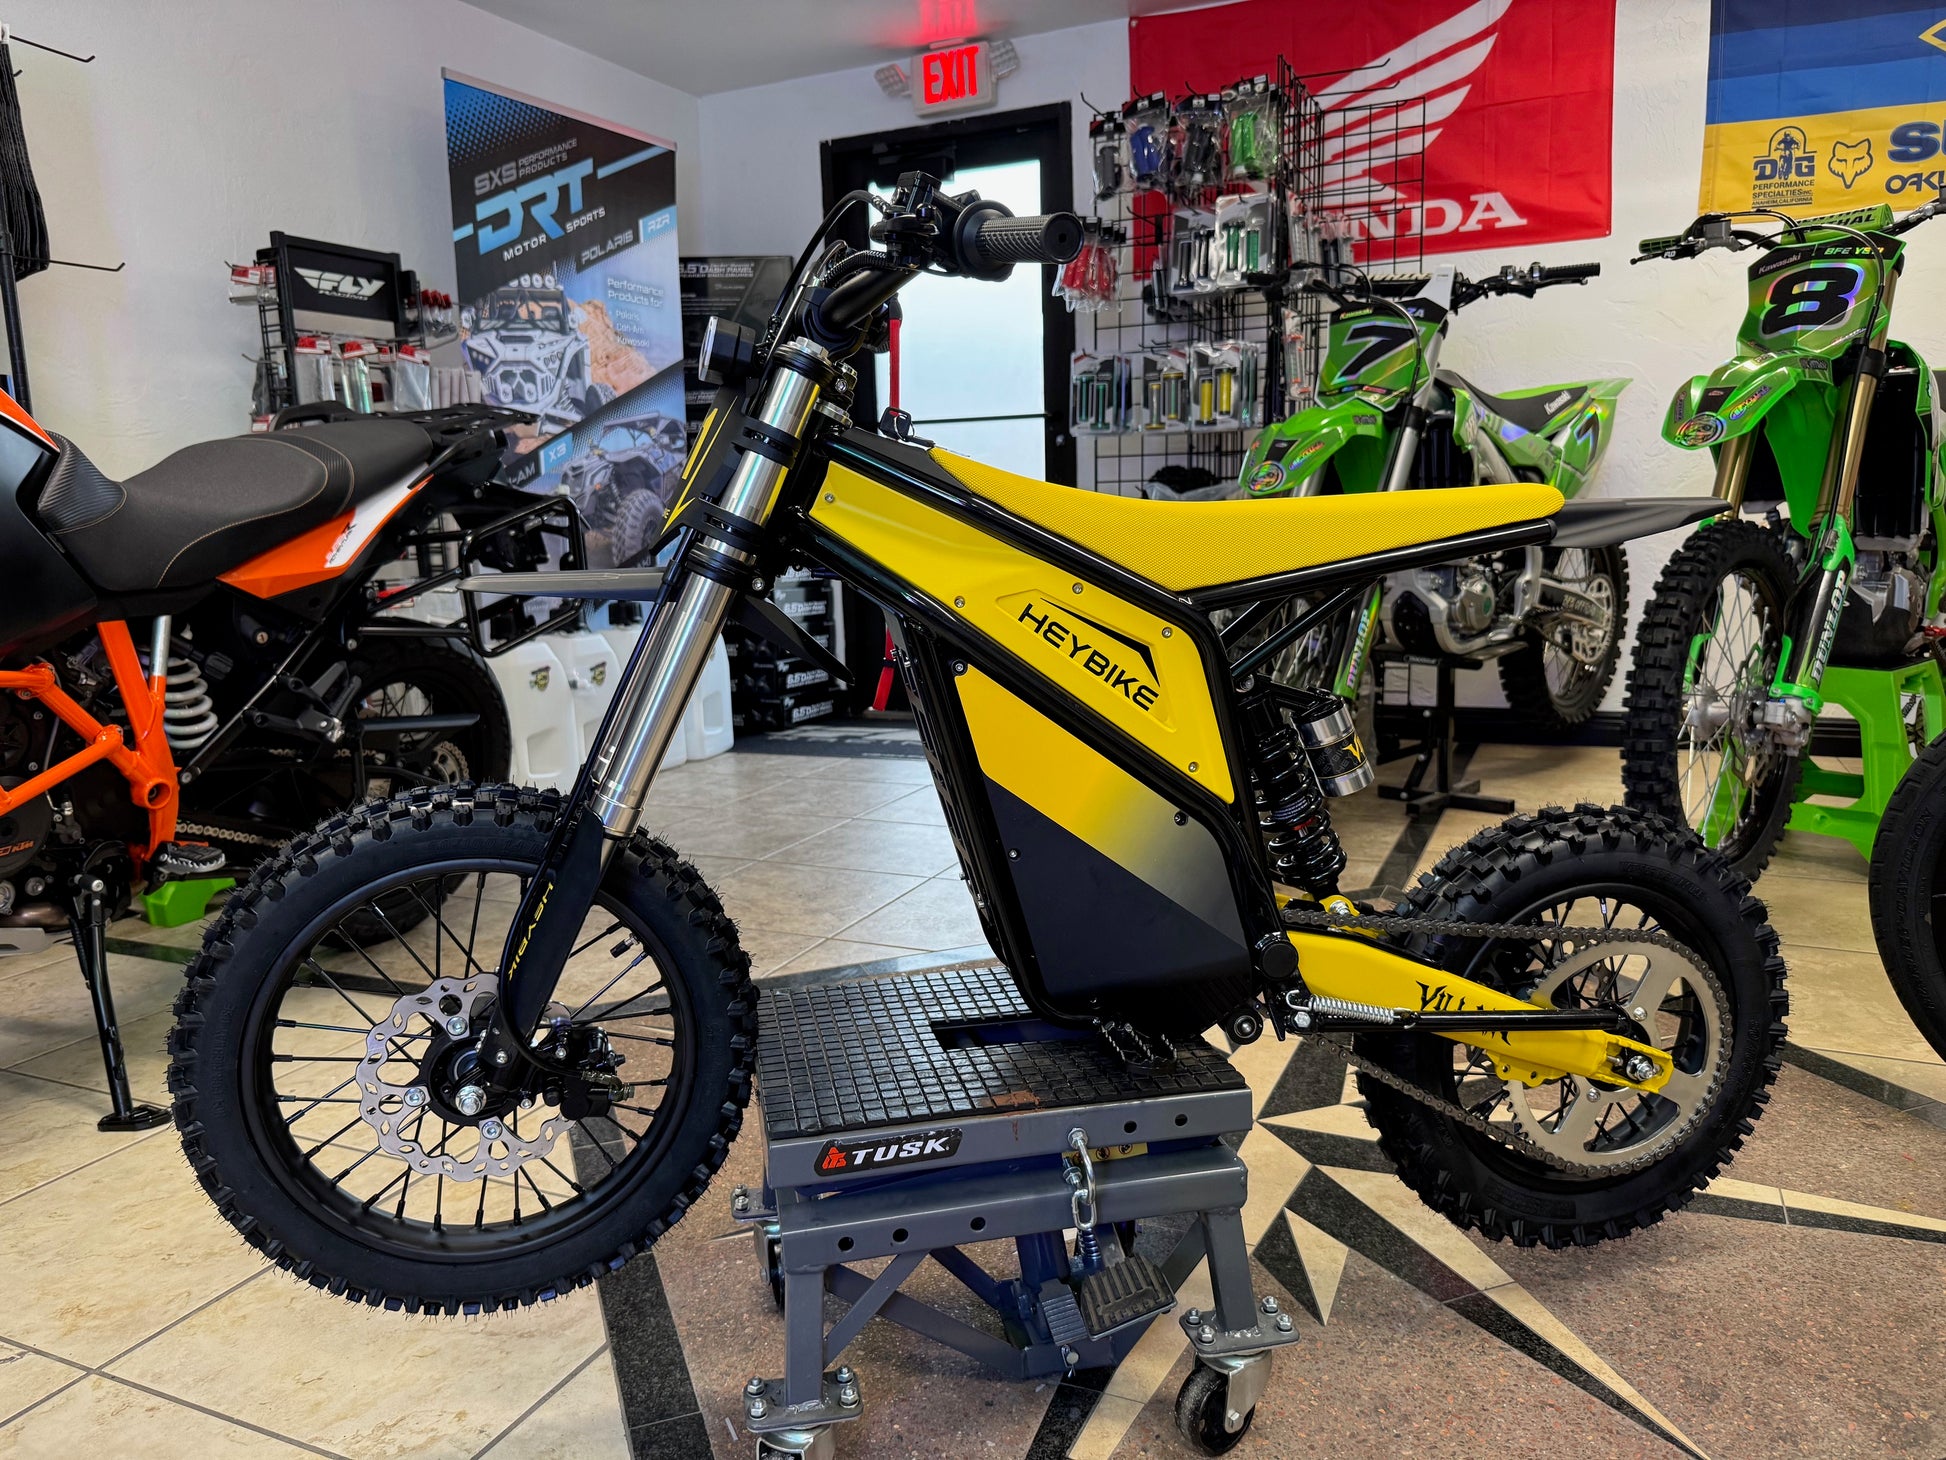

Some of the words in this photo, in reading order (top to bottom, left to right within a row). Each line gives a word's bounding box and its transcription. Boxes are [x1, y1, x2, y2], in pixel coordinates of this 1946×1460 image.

[922, 46, 979, 104] EXIT
[518, 138, 578, 168] PERFORMANCE
[1887, 120, 1946, 163] S
[474, 161, 517, 196] SXS
[519, 152, 568, 179] PRODUCTS
[1752, 179, 1815, 191] PERFORMANCE
[1752, 189, 1803, 200] SPECIALTIES
[1779, 196, 1813, 204] CALIFORNIA
[476, 157, 593, 255] DRT
[565, 206, 606, 234] SPORTS
[1351, 191, 1528, 242] NDA
[648, 214, 670, 233] RZR
[503, 232, 547, 262] MOTOR
[581, 229, 634, 265] POLARIS
[1759, 251, 1802, 275] Kawasaki
[294, 266, 386, 298] FLY
[607, 277, 664, 297] Performance
[607, 290, 649, 306] Products
[1761, 263, 1865, 338] 8
[615, 309, 641, 321] Polaris
[1332, 321, 1427, 386] 7
[548, 442, 567, 463] X3
[1810, 570, 1847, 685] DUNLOP
[1018, 603, 1159, 711] HEYBIKE
[1346, 608, 1370, 690] DUNLOP
[852, 1136, 950, 1165] TUSK
